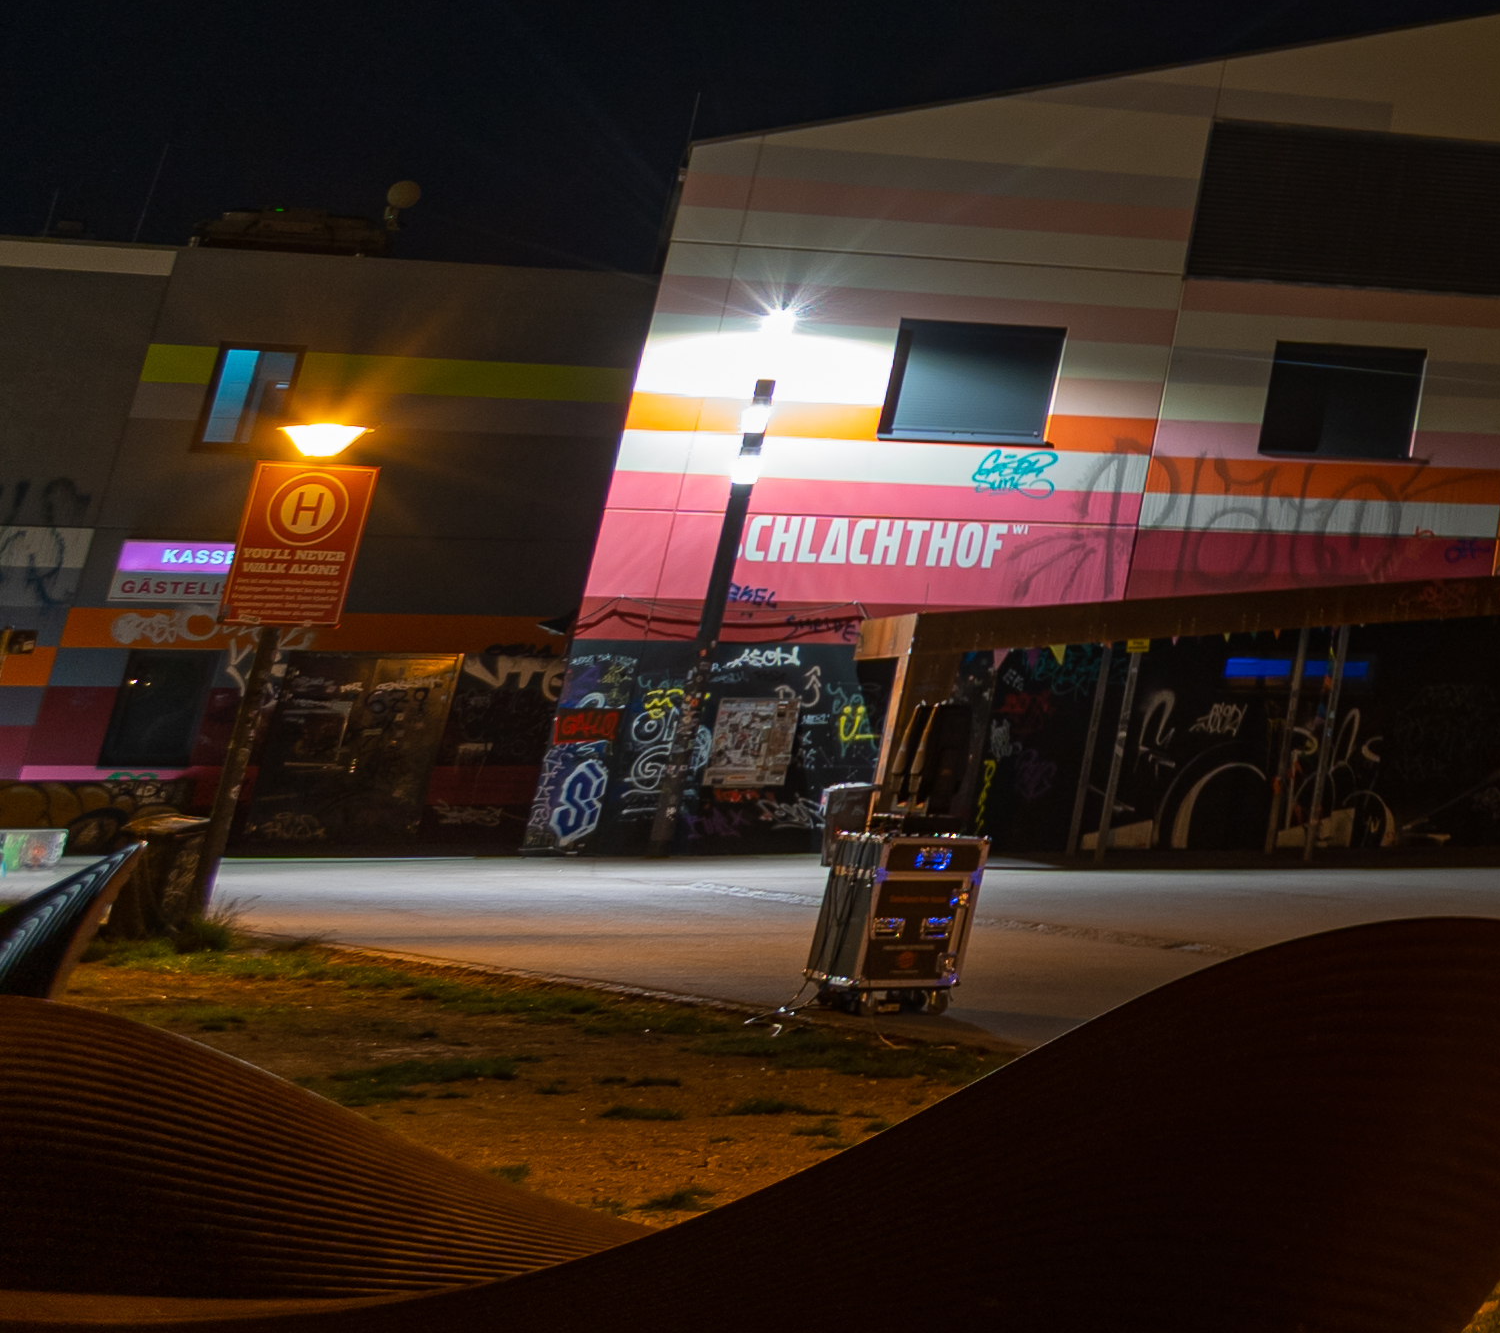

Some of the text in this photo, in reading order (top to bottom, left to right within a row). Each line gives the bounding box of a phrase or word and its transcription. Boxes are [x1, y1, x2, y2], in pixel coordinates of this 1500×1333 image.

[290, 491, 326, 527] H
[736, 515, 1009, 569] CHLACHTHOF
[294, 550, 347, 562] NEVER
[242, 561, 341, 576] WALK ALONE
[120, 577, 225, 595] GÄSTELI
